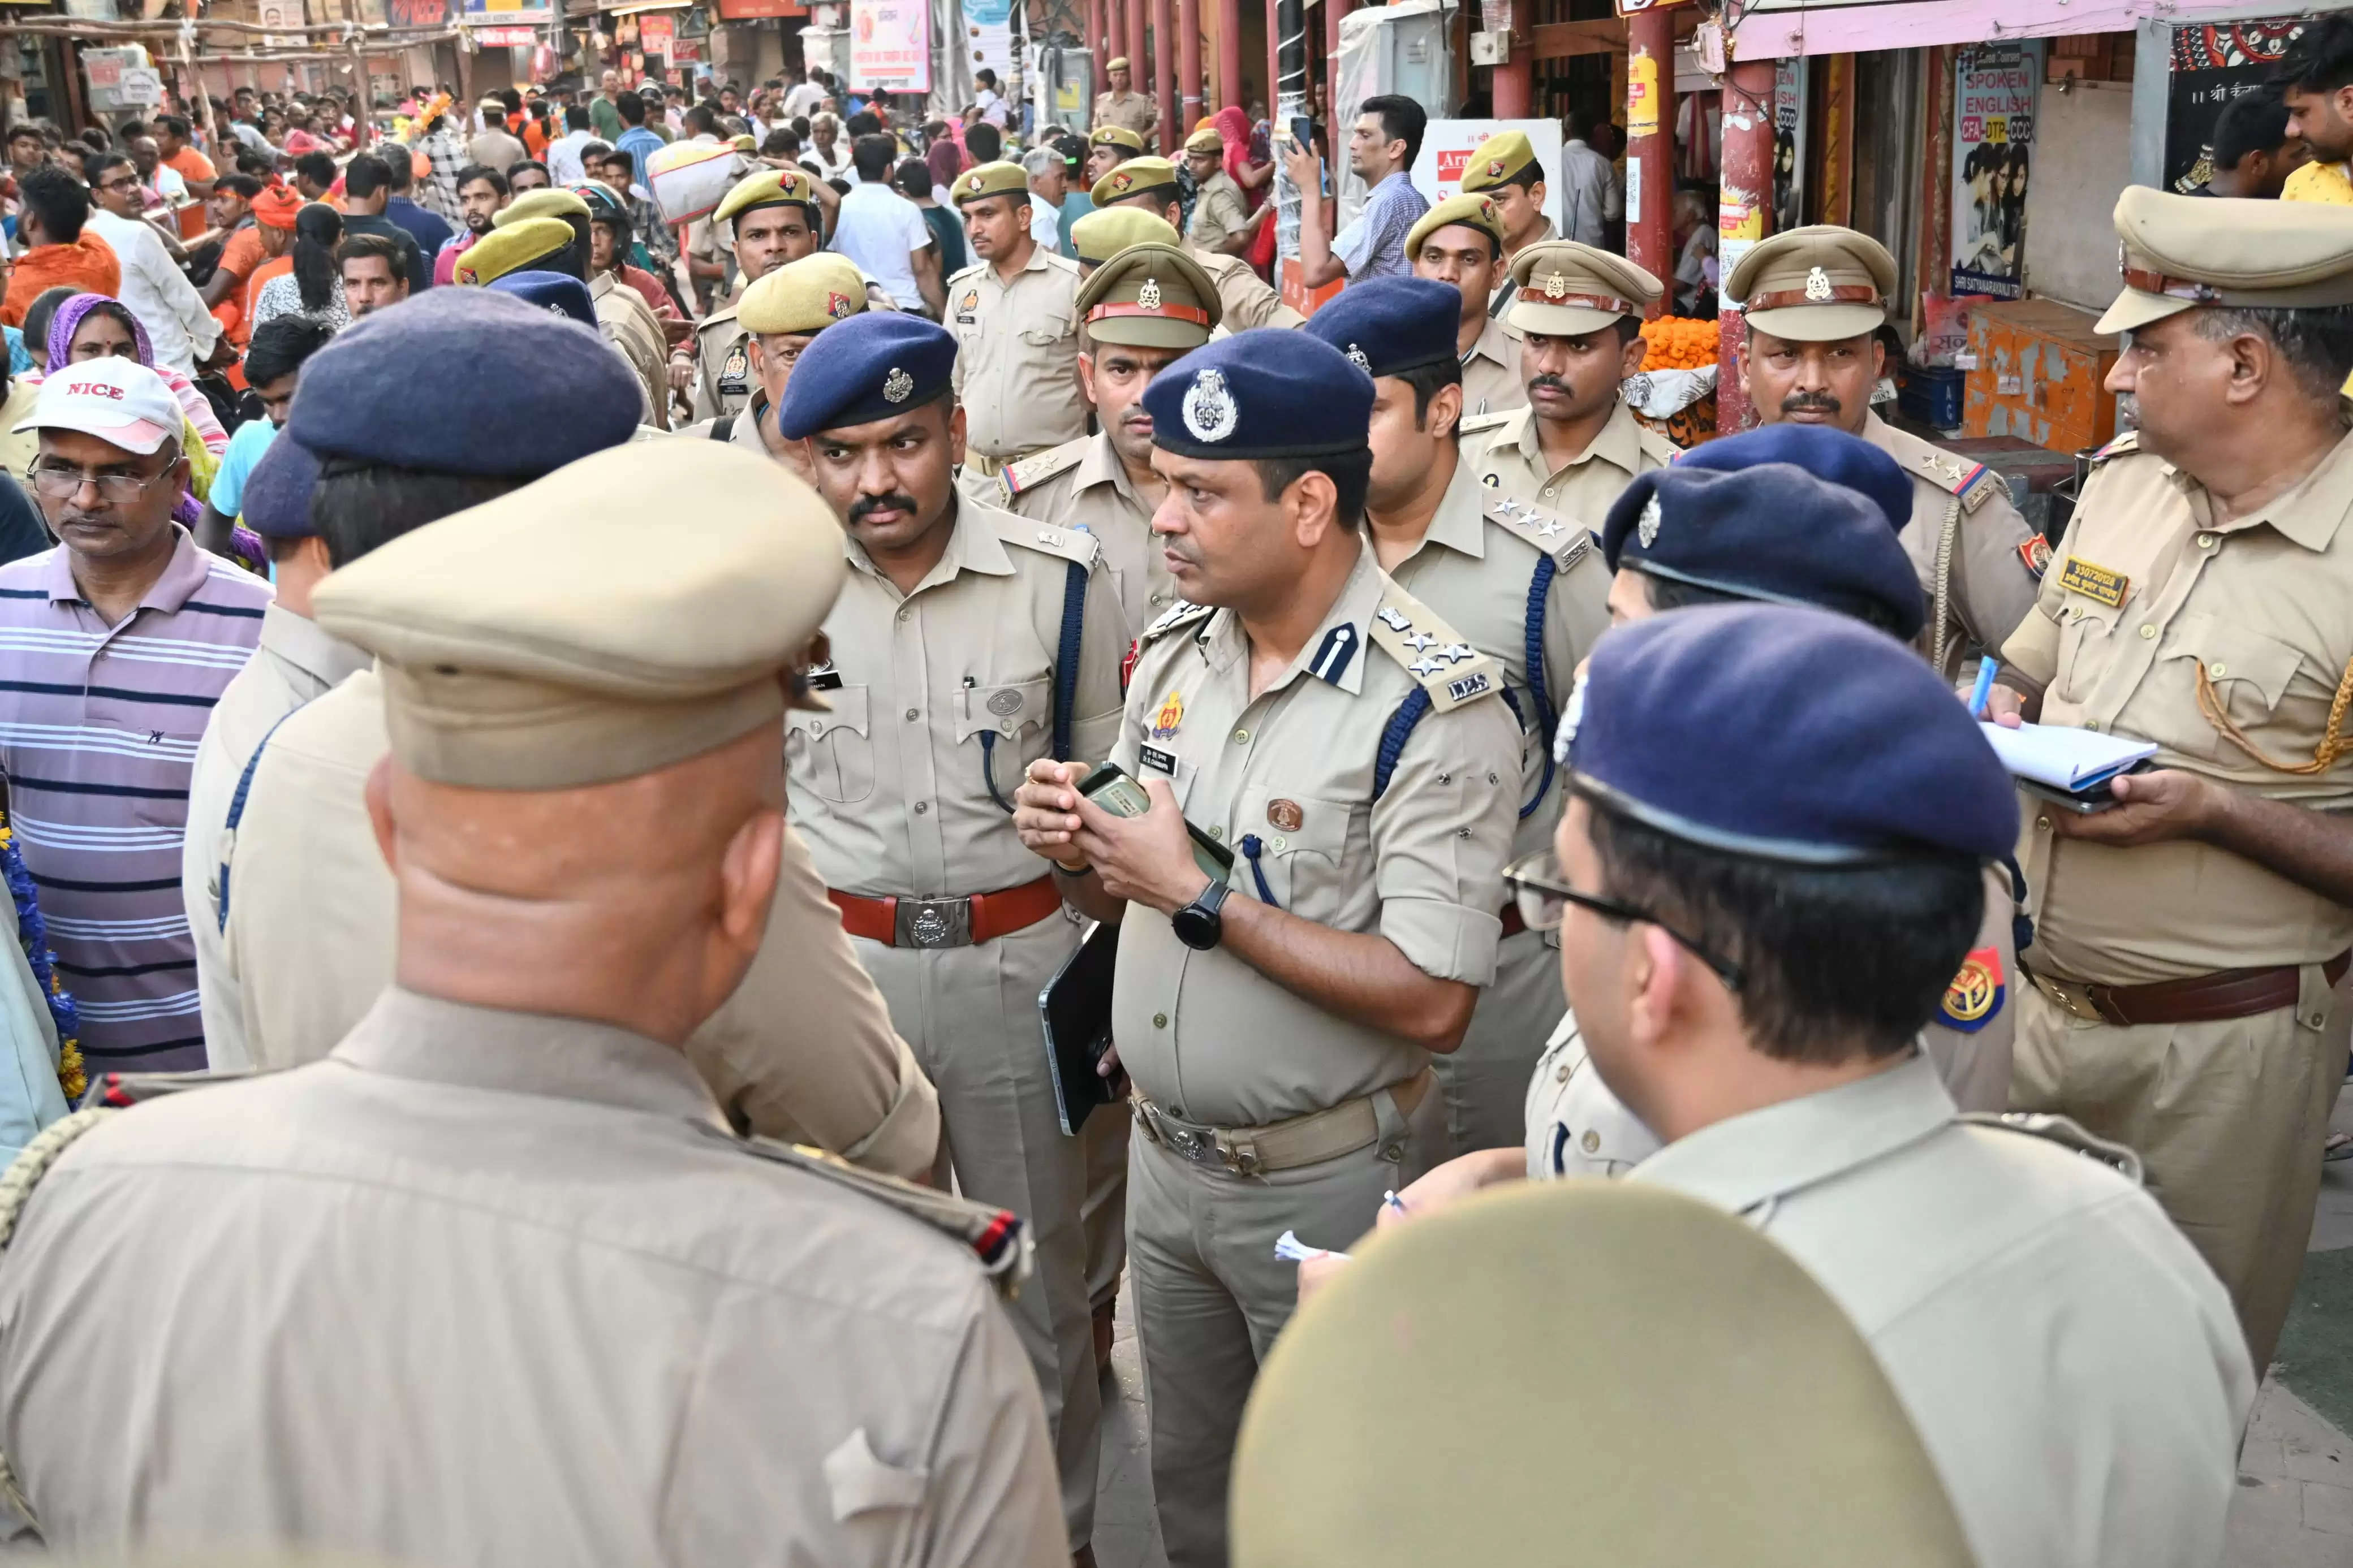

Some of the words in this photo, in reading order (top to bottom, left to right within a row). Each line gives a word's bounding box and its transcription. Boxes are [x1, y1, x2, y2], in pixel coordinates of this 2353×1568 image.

[1966, 71, 2028, 89] SPOKEN
[1966, 96, 2032, 114] ENGLISH
[67, 383, 124, 401] NICE
